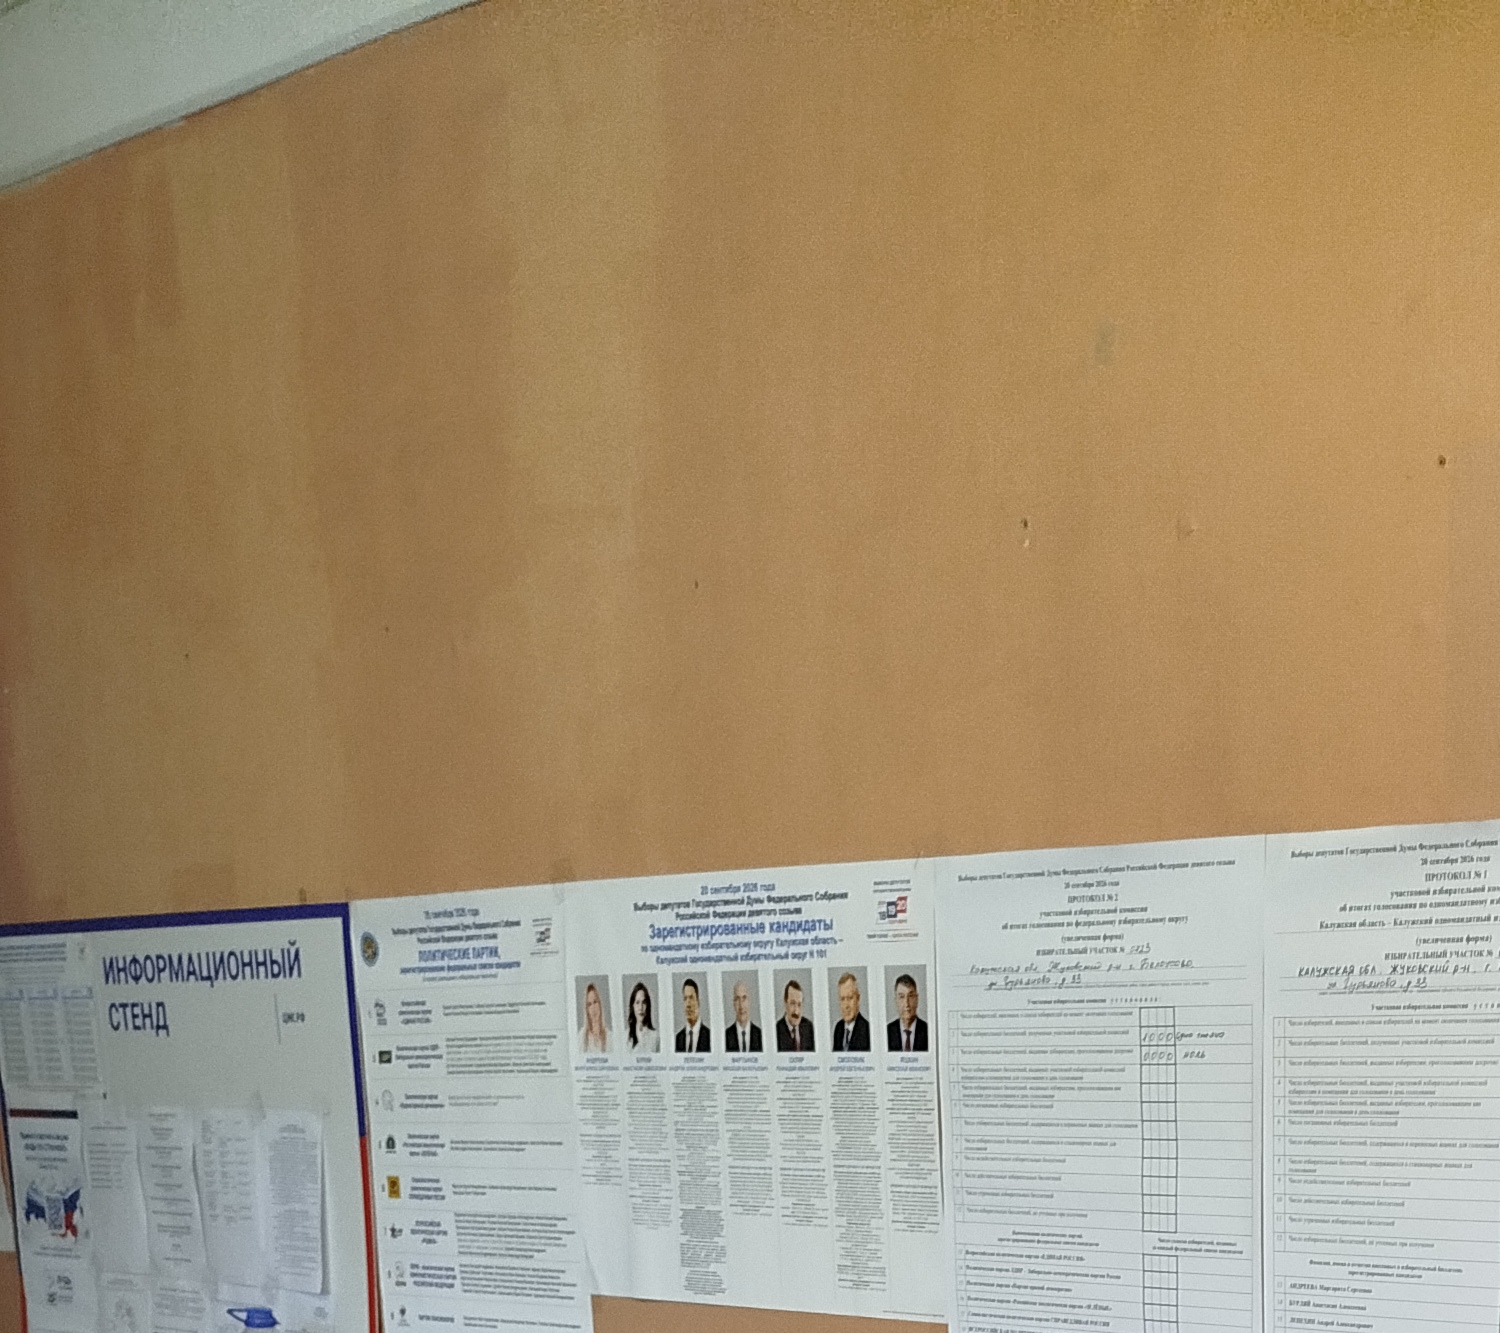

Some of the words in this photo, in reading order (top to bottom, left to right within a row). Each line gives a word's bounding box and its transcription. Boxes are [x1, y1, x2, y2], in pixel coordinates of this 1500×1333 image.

[1425, 871, 1471, 882] ПРОТОКОЛ
[1473, 871, 1481, 879] №
[1484, 870, 1487, 879] 1
[710, 884, 741, 895] сентября
[760, 883, 776, 892] года
[1390, 888, 1431, 899] участковой
[1432, 885, 1485, 897] избирательной
[633, 902, 659, 912] Выборы
[660, 901, 691, 911] депутатов
[692, 897, 745, 909] Государственной
[746, 895, 764, 907] Думы
[766, 894, 813, 904] Федерального
[815, 891, 848, 901] Собрания
[1339, 903, 1347, 912] об
[1373, 903, 1417, 911] голосования
[1429, 899, 1487, 908] одномандатному
[675, 911, 710, 921] Российской
[712, 910, 746, 919] Федерации
[747, 909, 777, 918] девятого
[778, 907, 802, 915] созыва
[1319, 921, 1357, 929] Калужская
[1358, 919, 1386, 927] область
[1393, 917, 1433, 926] Калужский
[1435, 914, 1491, 924] одномандатный
[649, 922, 765, 942] Зарегистрированные
[769, 919, 833, 935] кандидаты
[1384, 949, 1447, 960] ИЗБИРАТЕЛЬНЫЙ
[1449, 950, 1484, 958] УЧАСТОК
[102, 939, 302, 988] ИНФОРМАЦИОННЫЙ
[108, 1002, 169, 1037] СТЕНД
